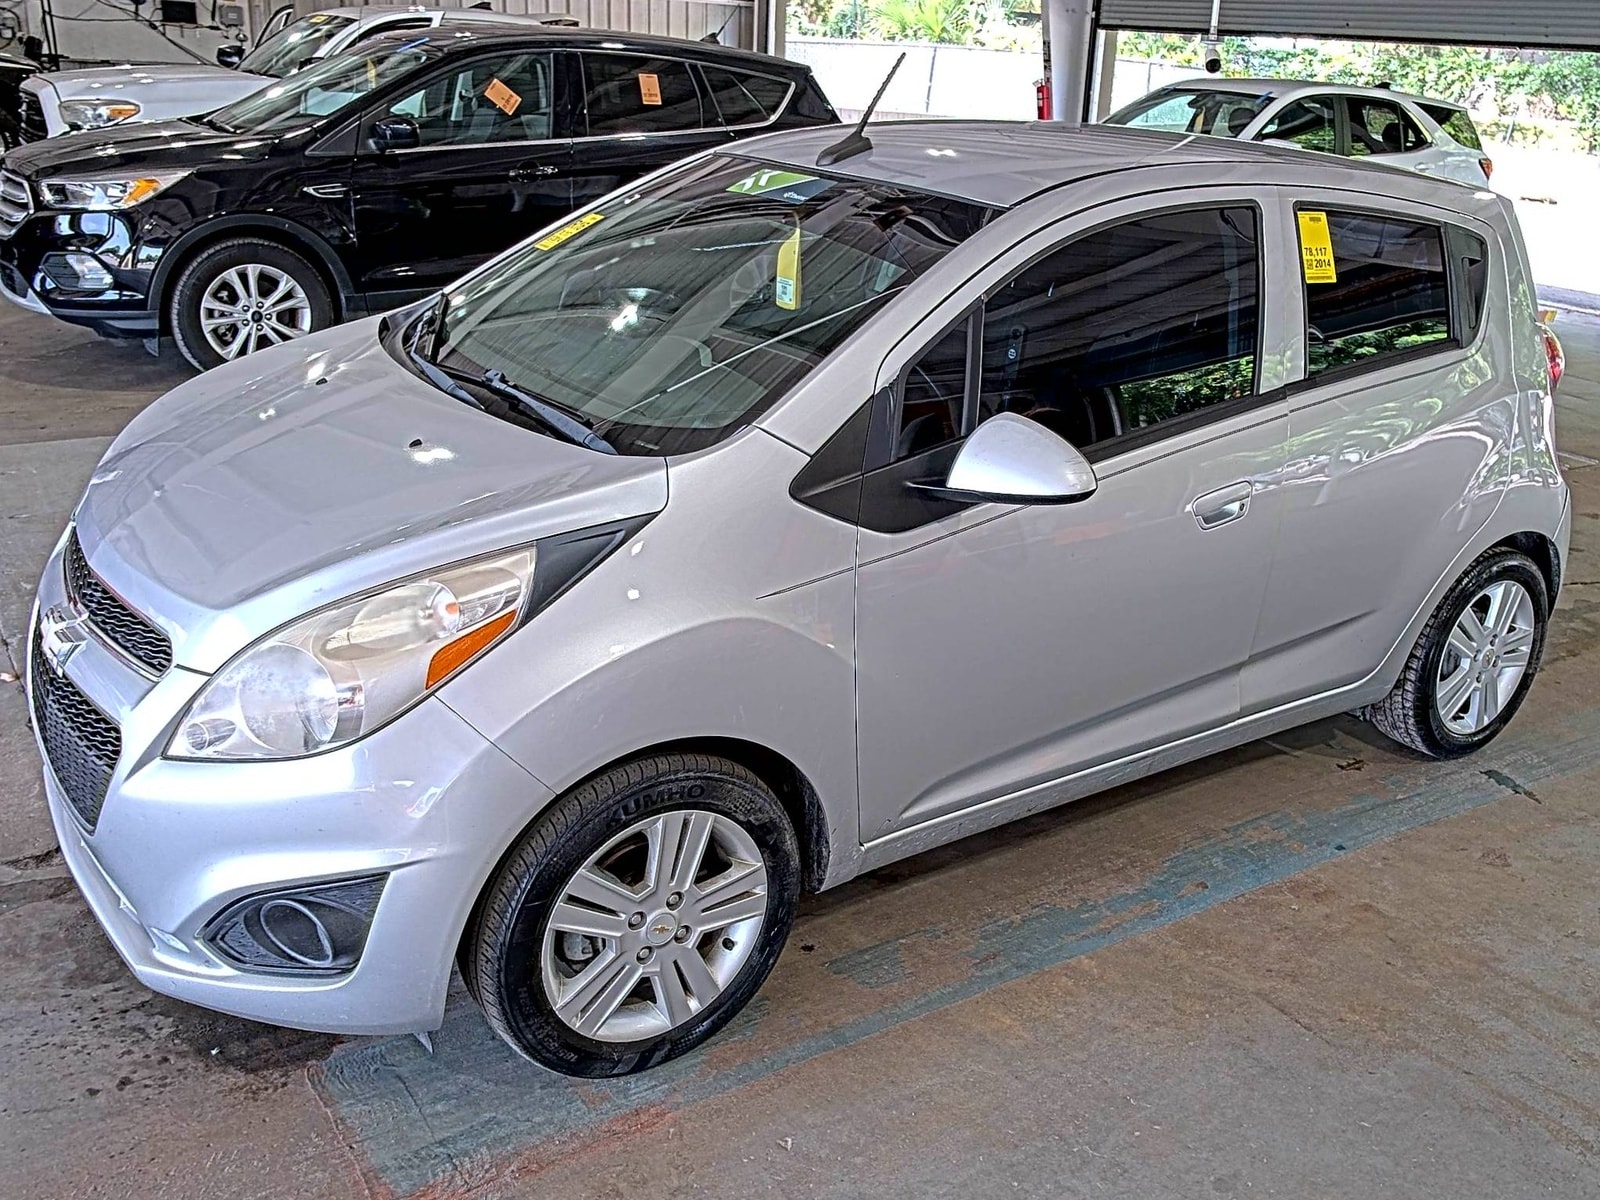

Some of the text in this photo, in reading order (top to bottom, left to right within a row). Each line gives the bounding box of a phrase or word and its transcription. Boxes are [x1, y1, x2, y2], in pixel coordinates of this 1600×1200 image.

[1304, 247, 1327, 257] 78,117
[1314, 259, 1331, 268] 2014
[606, 784, 706, 827] KUMHO
